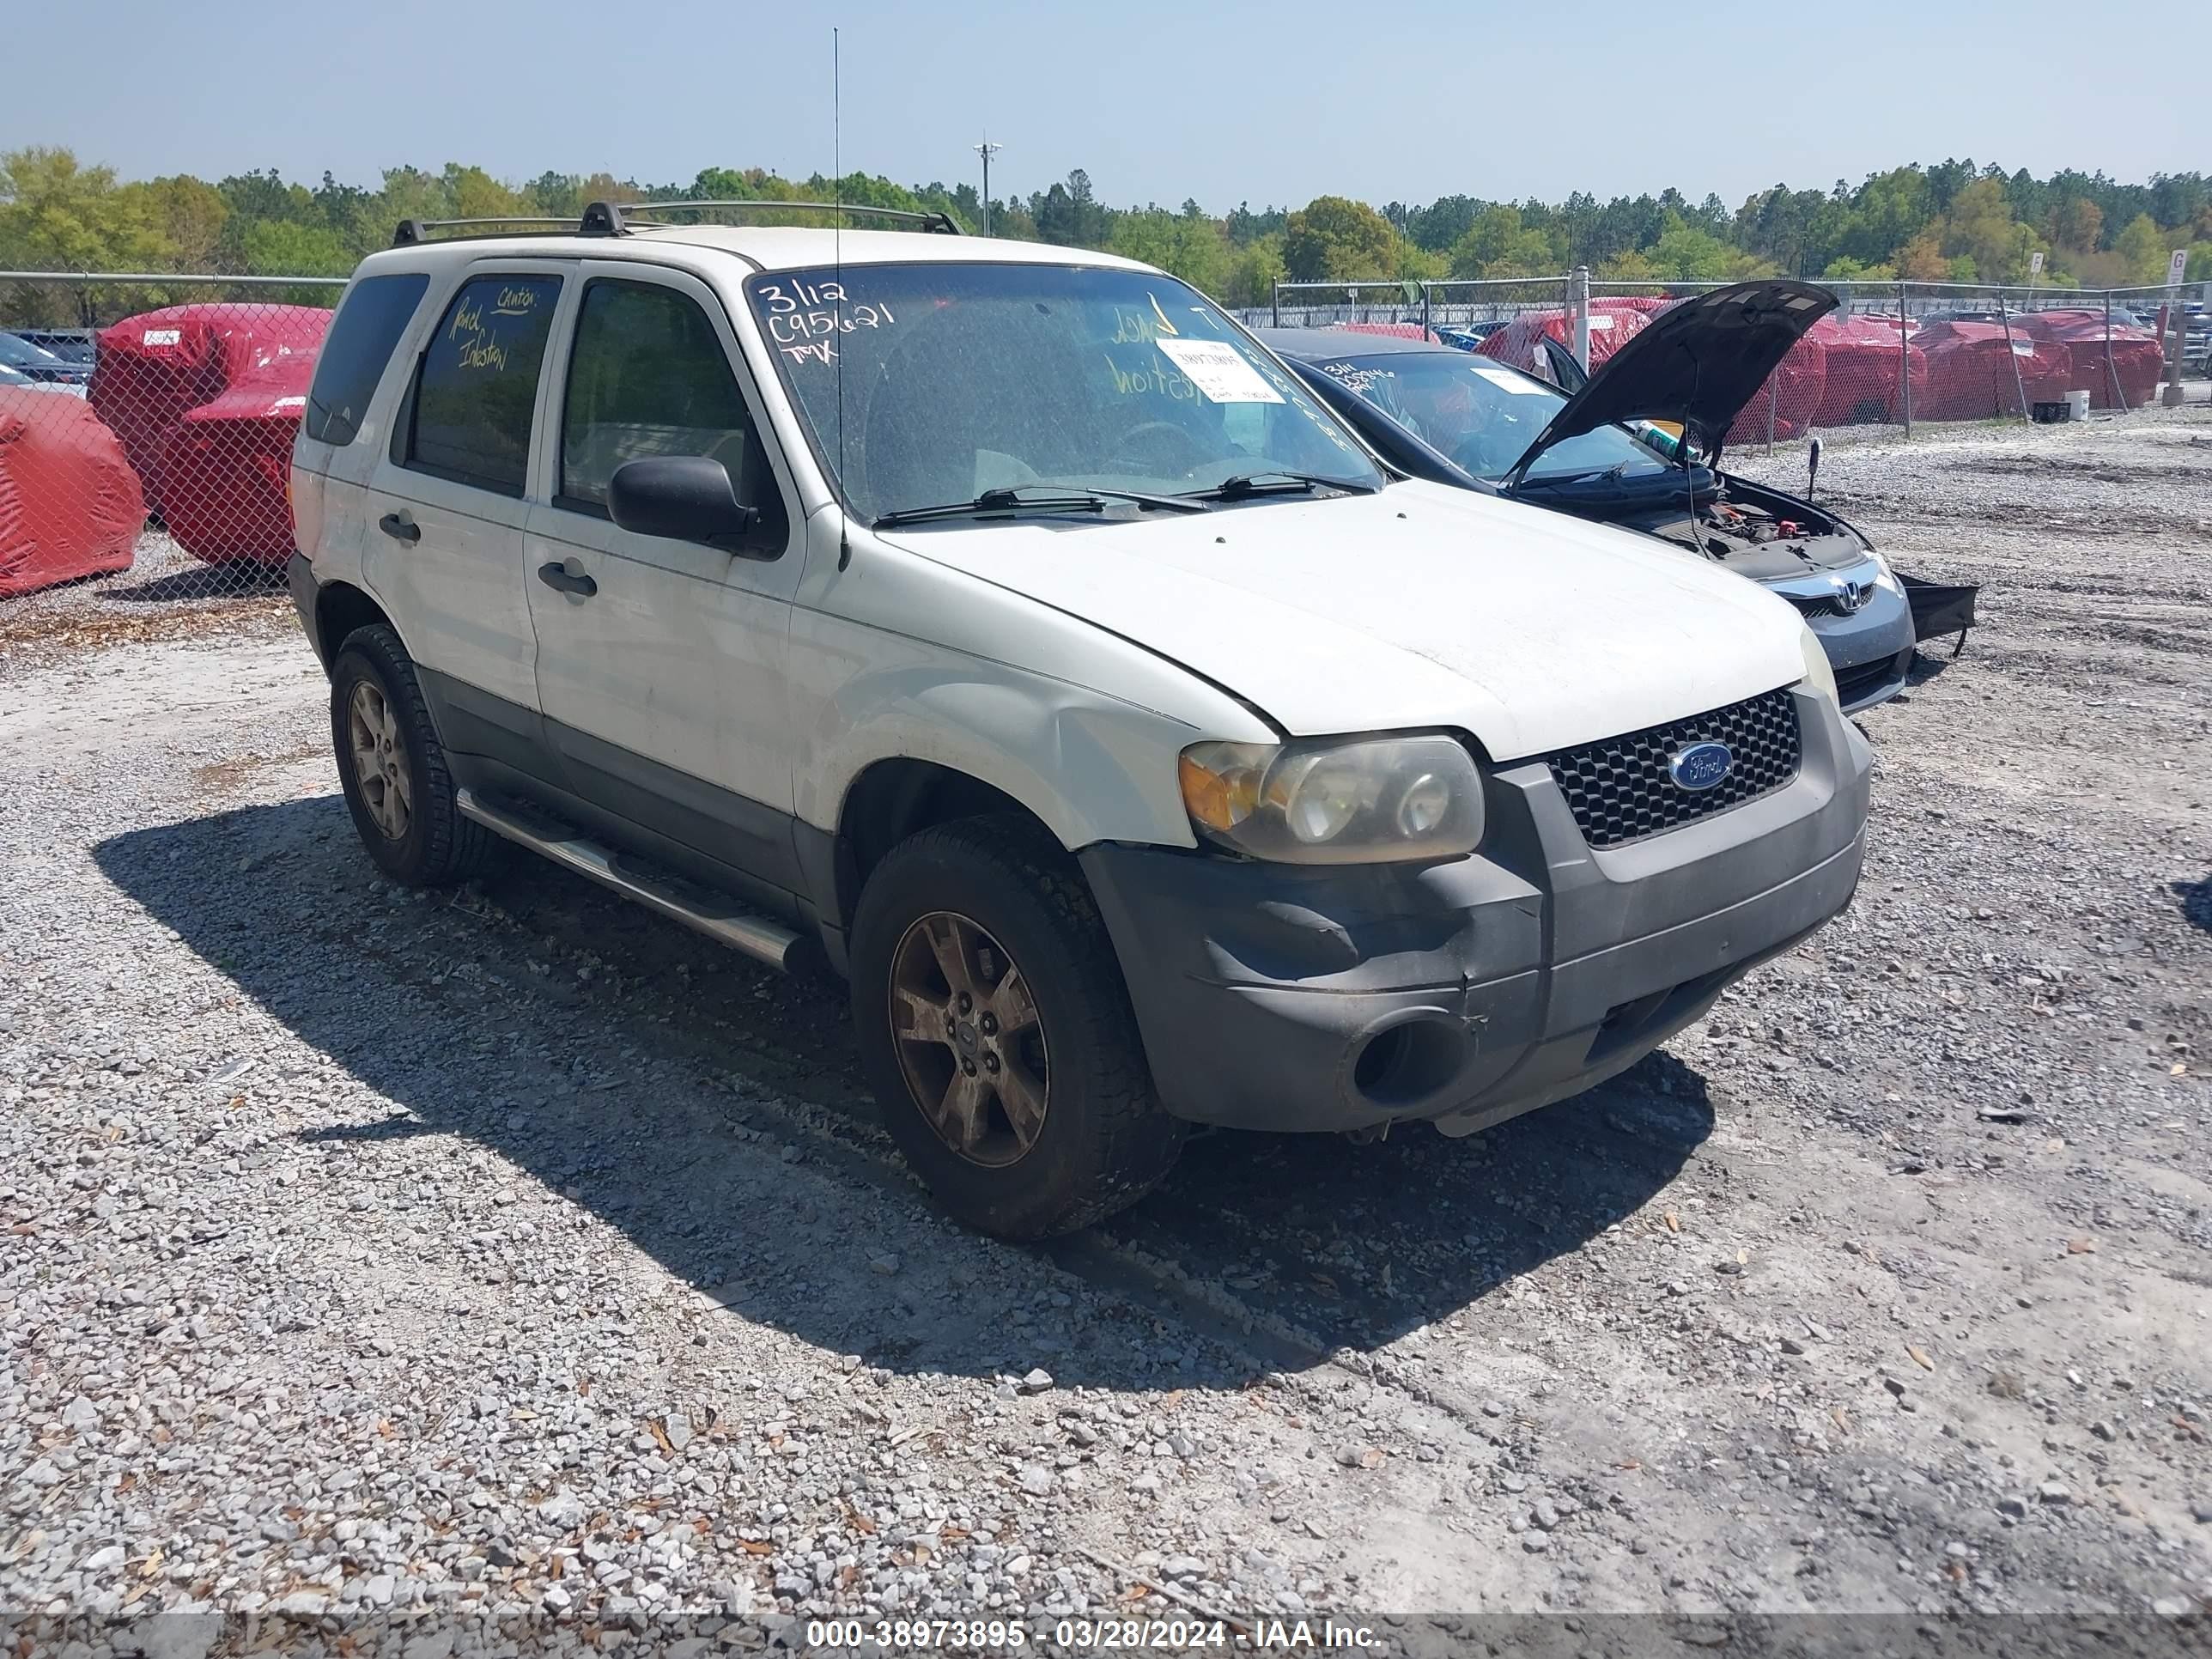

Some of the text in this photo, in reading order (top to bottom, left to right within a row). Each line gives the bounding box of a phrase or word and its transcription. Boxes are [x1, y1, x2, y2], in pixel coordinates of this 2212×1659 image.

[2174, 252, 2184, 268] G
[759, 279, 848, 313] 3/12
[769, 303, 894, 343] C95621
[1689, 752, 1722, 781] Ford
